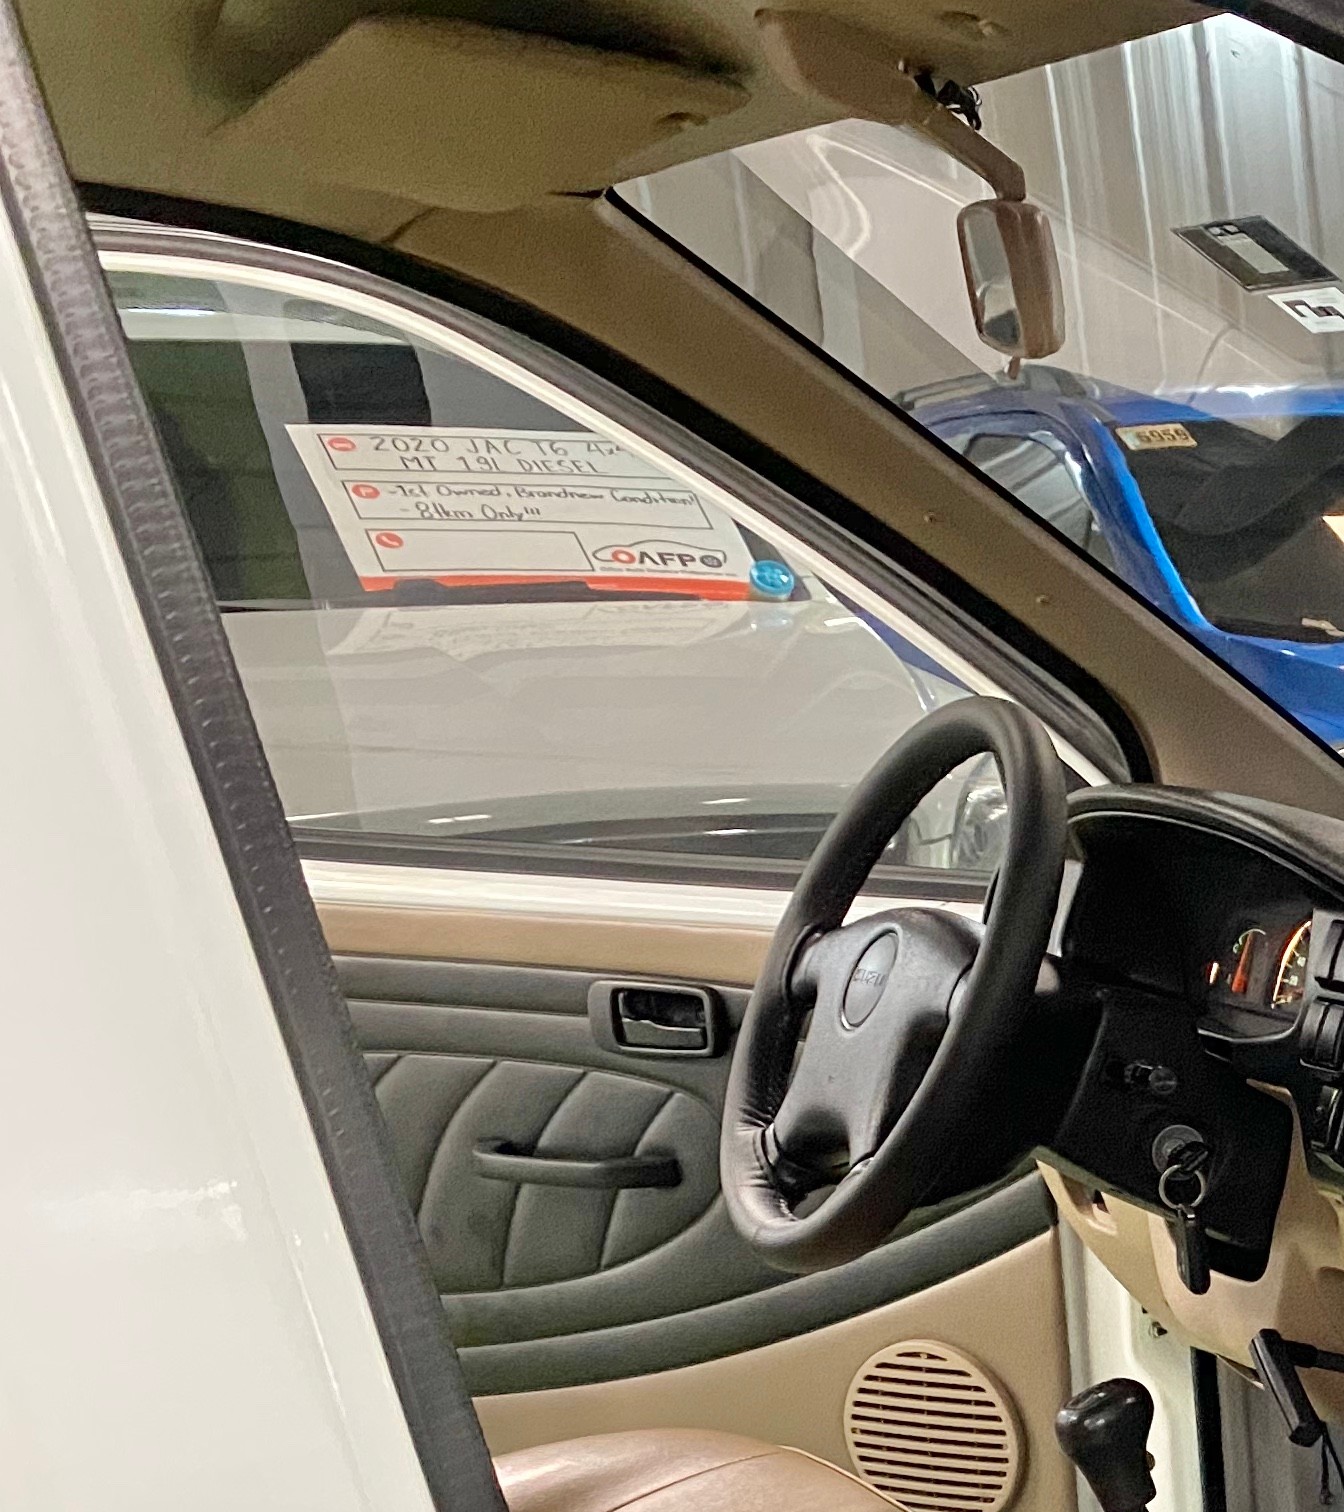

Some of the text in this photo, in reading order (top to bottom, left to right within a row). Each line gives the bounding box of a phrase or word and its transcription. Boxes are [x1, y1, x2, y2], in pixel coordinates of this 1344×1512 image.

[368, 436, 450, 453] 2020
[466, 438, 522, 455] JAC
[399, 455, 437, 472] MT
[516, 458, 609, 474] DIESEL
